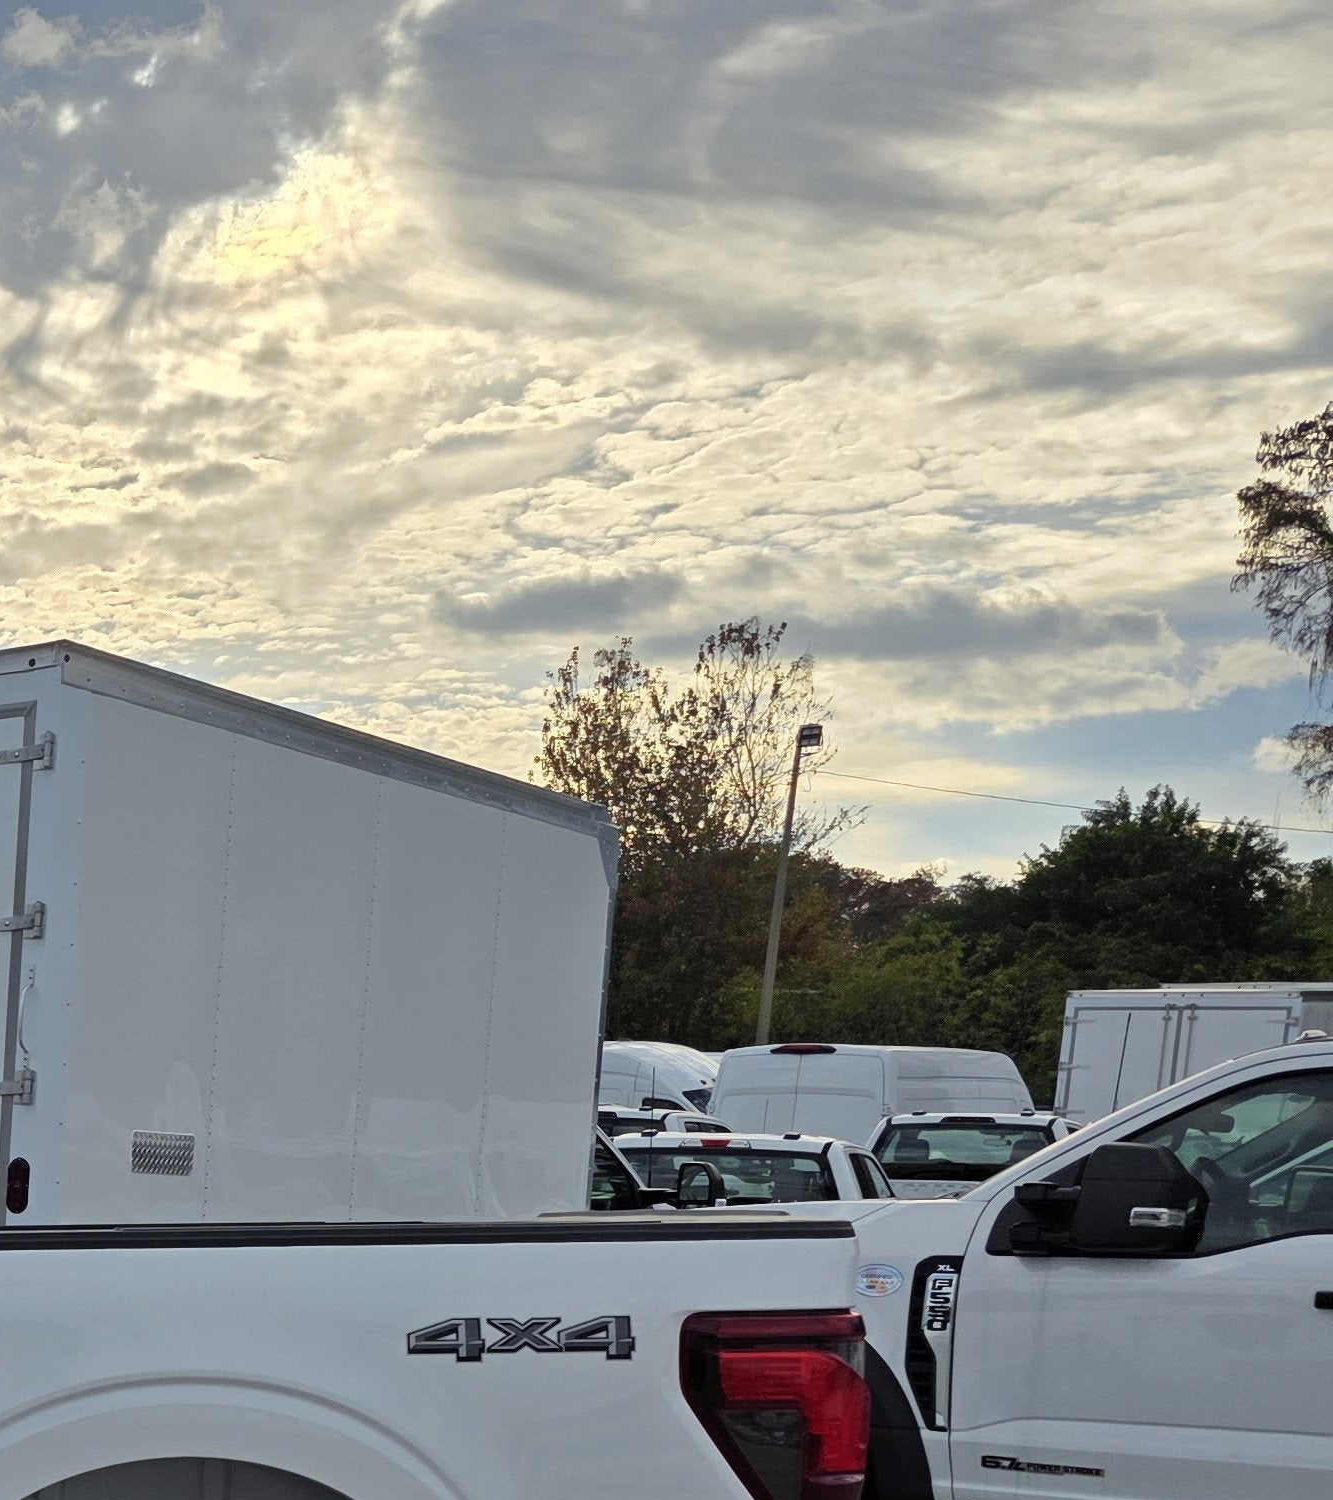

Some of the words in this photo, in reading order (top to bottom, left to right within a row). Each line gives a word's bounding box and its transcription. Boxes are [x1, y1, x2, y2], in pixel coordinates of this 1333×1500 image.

[936, 1264, 955, 1272] XL
[1026, 1462, 1061, 1473] POWER
[1062, 1465, 1105, 1477] STROKE
